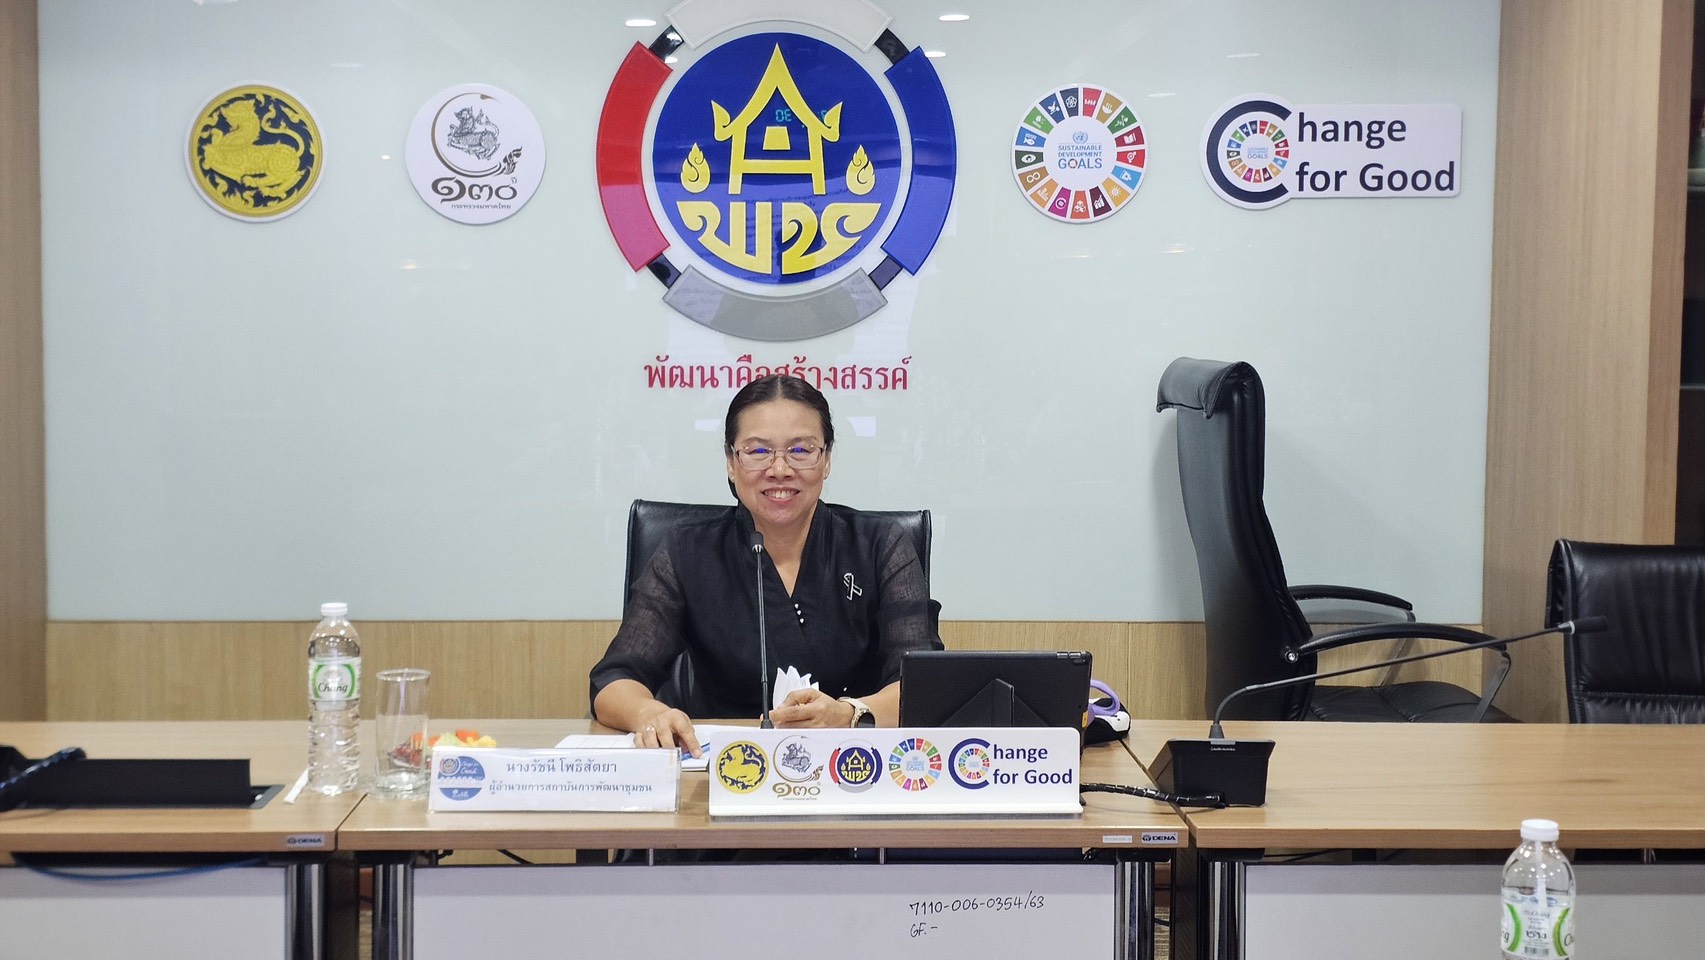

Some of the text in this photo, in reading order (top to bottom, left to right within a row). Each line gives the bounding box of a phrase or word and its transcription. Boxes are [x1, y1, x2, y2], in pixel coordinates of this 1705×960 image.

[1058, 158, 1102, 169] GOALS
[1295, 161, 1455, 192] for Good
[431, 176, 517, 204] ๑๓๐
[993, 769, 1072, 784] for Good
[909, 890, 1045, 916] 7110-006-0354/63
